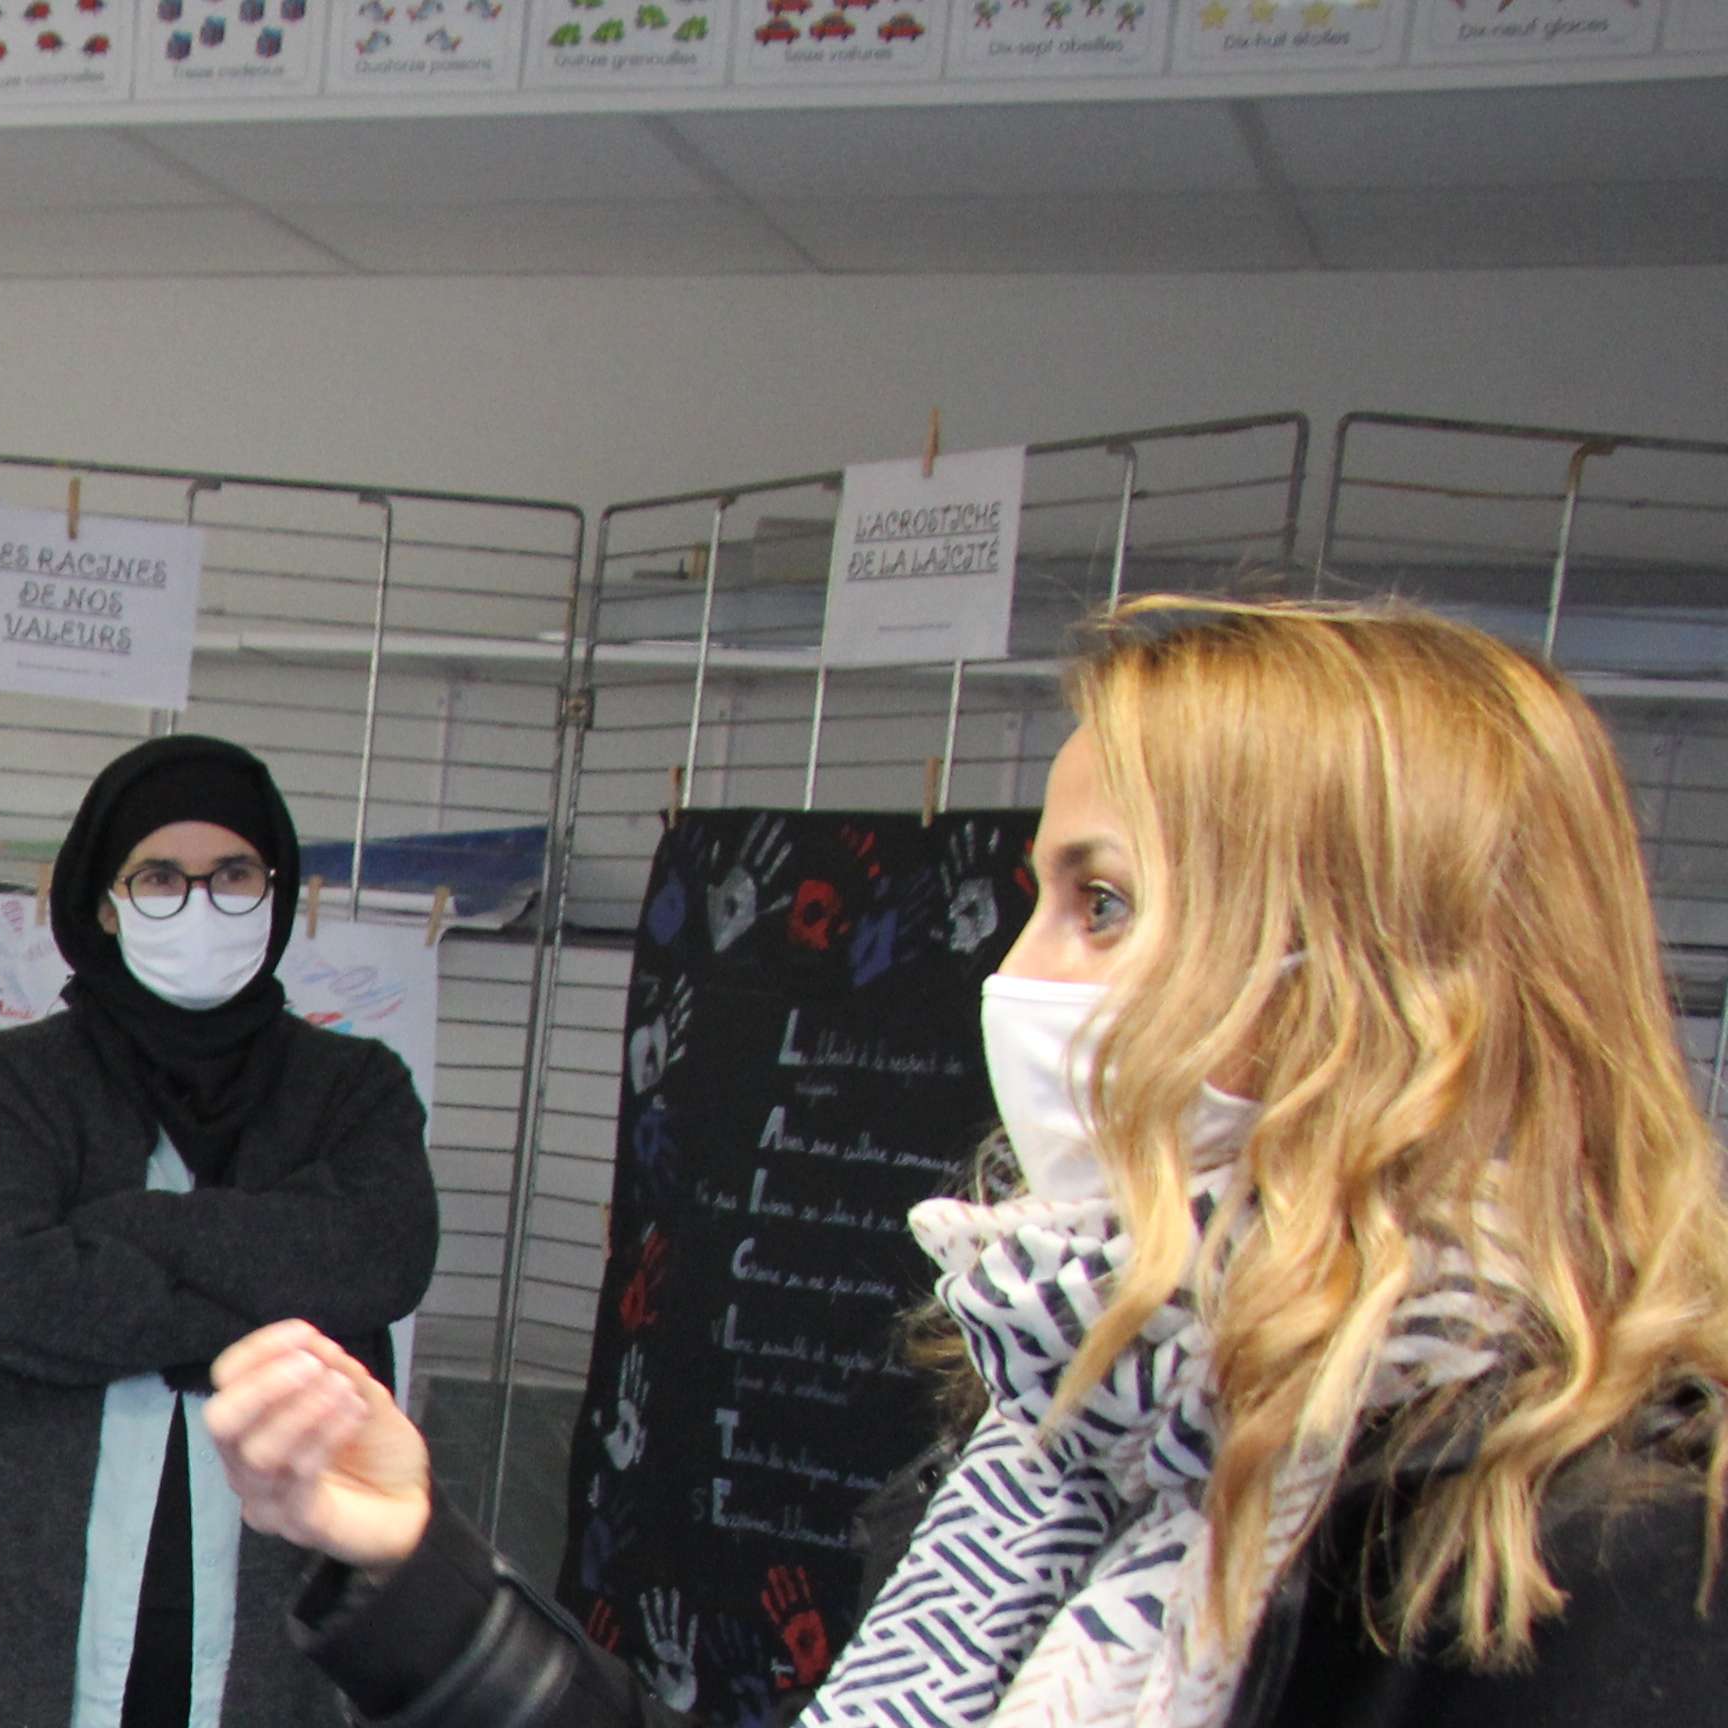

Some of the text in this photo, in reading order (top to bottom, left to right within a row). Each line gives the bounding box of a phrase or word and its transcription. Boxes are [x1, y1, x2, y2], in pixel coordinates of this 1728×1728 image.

[36, 546, 169, 586] RACINES
[847, 553, 875, 578] DE
[879, 548, 908, 577] LA
[18, 579, 125, 617] DE NOS
[3, 613, 134, 651] VALEURS
